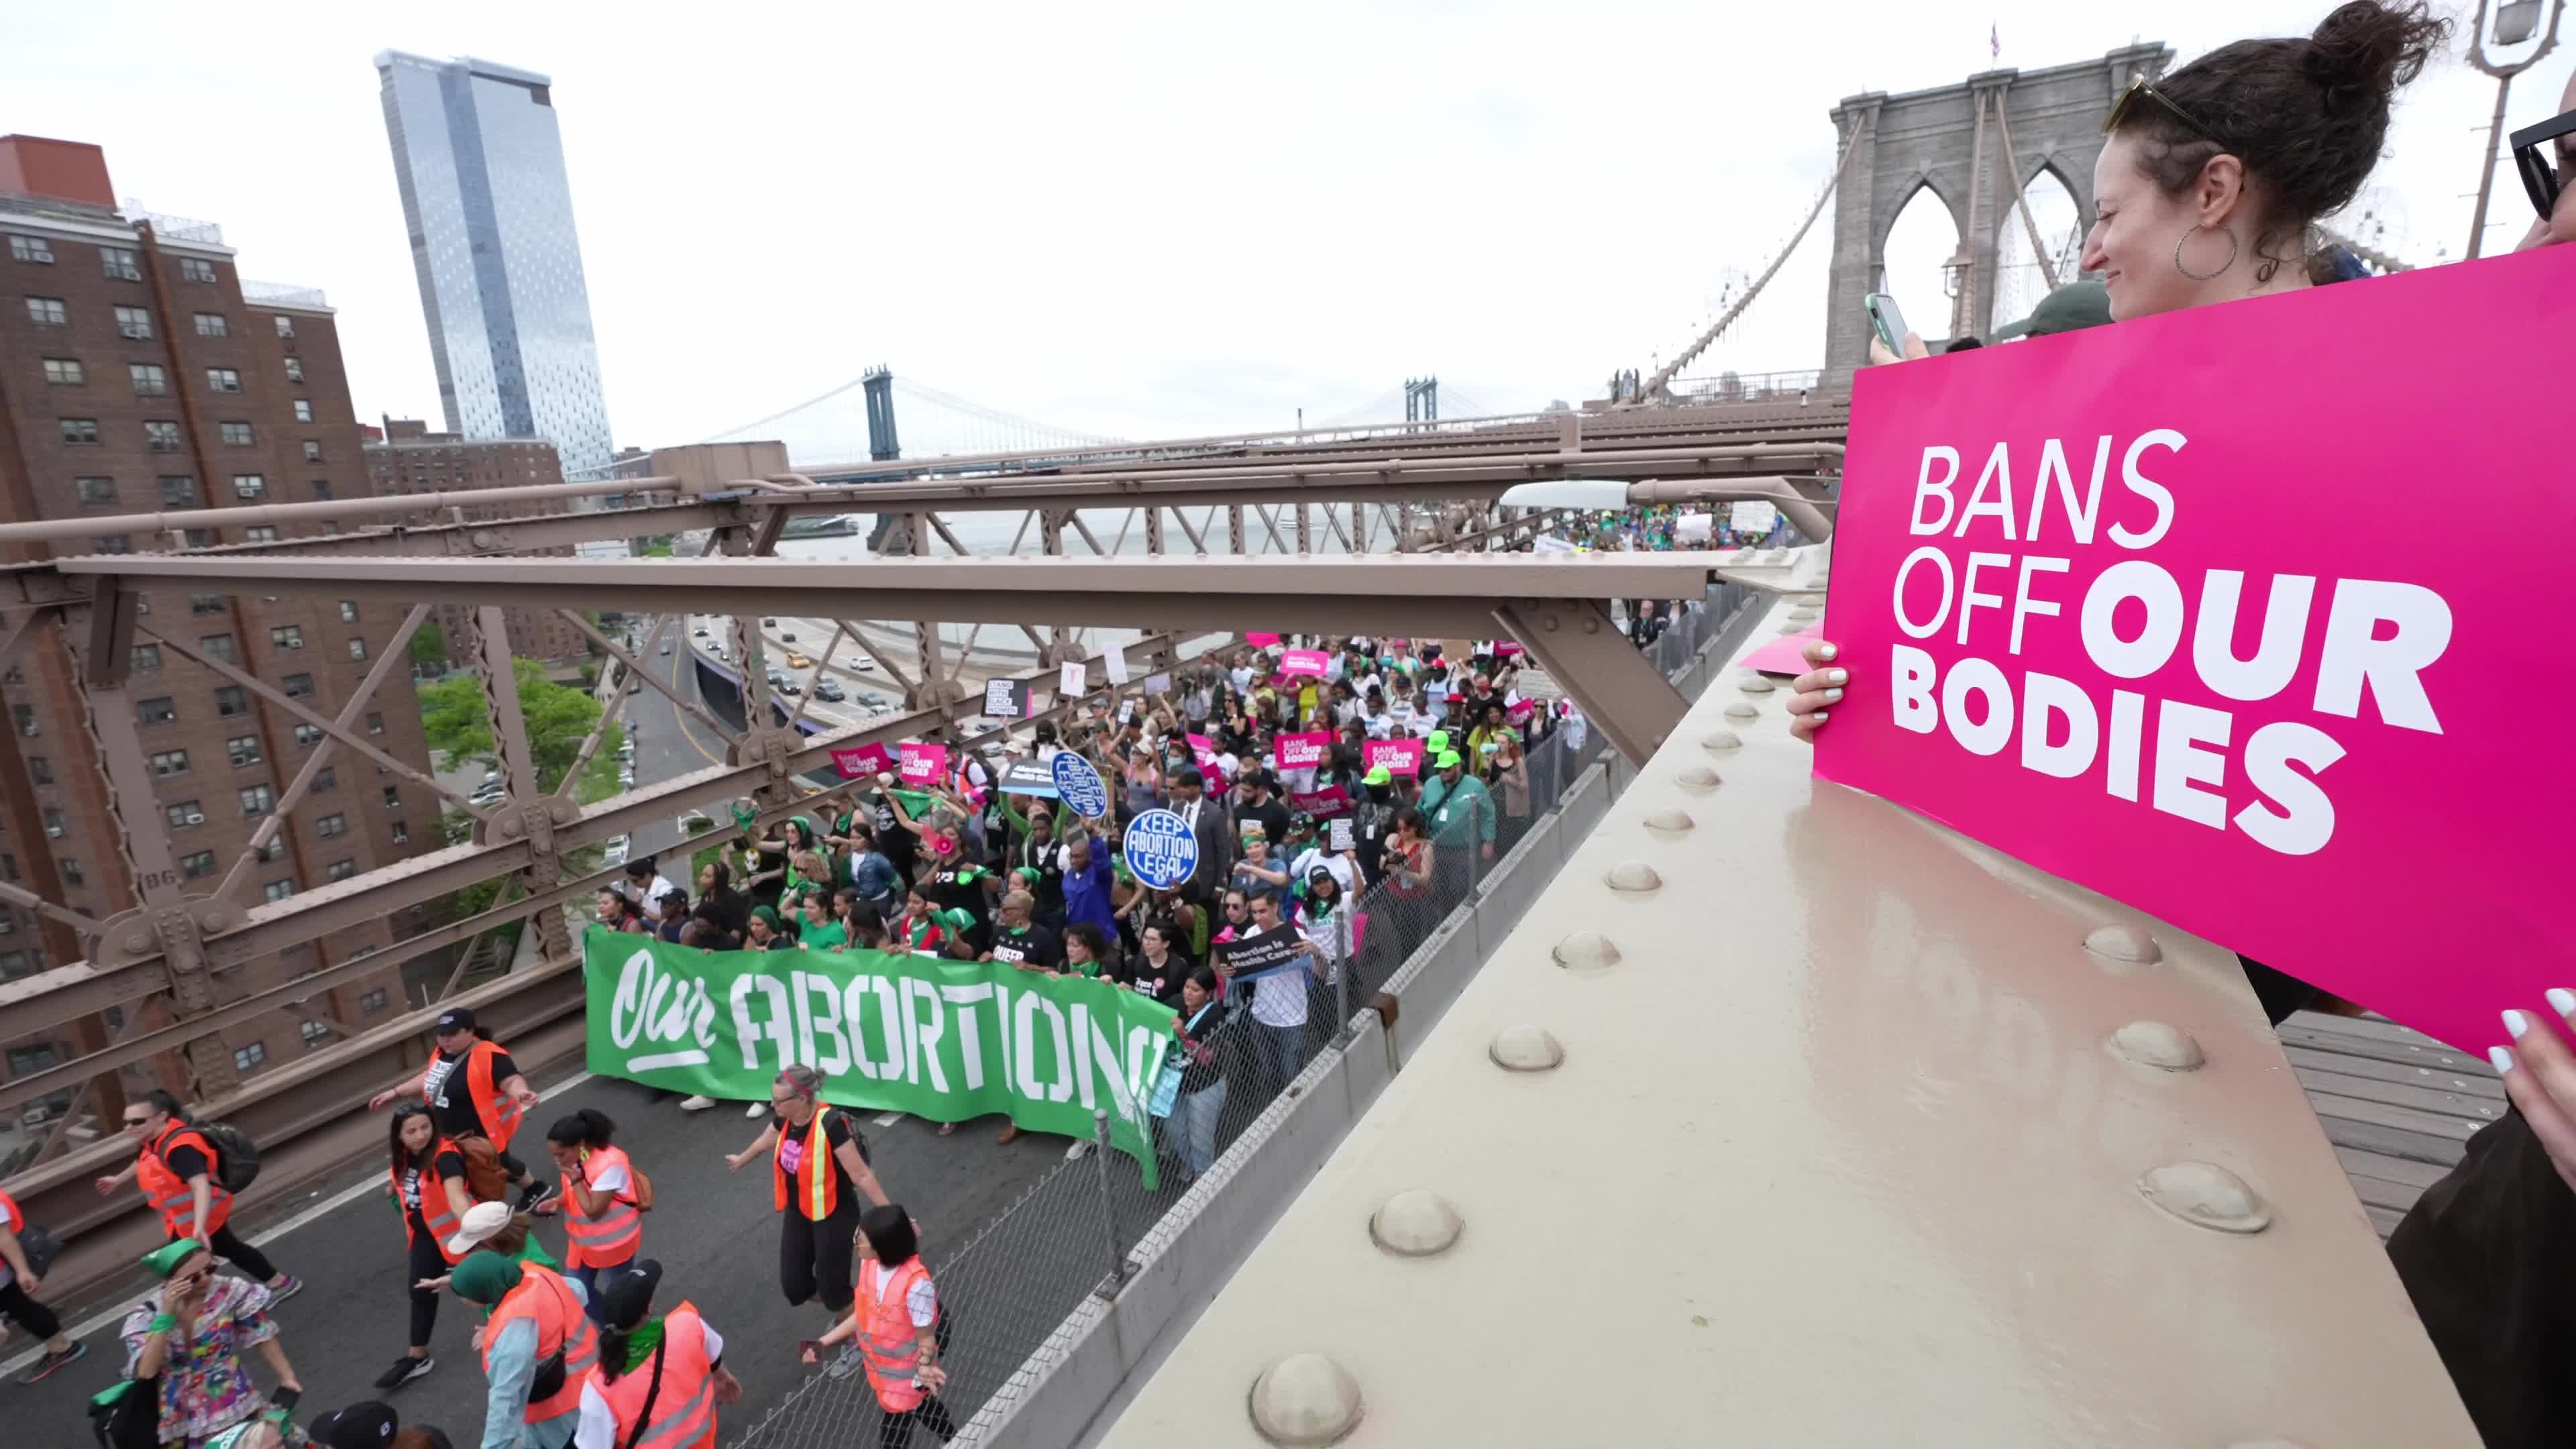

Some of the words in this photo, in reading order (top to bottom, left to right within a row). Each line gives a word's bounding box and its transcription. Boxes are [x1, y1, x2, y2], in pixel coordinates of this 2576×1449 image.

[1910, 428, 2188, 549] BANS
[1892, 546, 2071, 655] OFF
[2080, 560, 2453, 735] OUR
[1283, 739, 1307, 747] BANS
[1372, 745, 1397, 753] BANS
[1391, 751, 1413, 761] OUR
[1892, 643, 2347, 856] BODIES
[913, 759, 934, 768] OUR
[1284, 754, 1320, 763] BODIES
[1056, 761, 1081, 810] LEGAL
[1063, 755, 1099, 815] ABORTION
[1083, 765, 1105, 807] KEEP
[1140, 812, 1185, 836] KEEP
[1128, 829, 1194, 861] ABORTION
[1134, 851, 1187, 878] LEGAL
[1227, 944, 1273, 960] Abortion
[1231, 955, 1267, 968] Health
[610, 948, 716, 1049] Our
